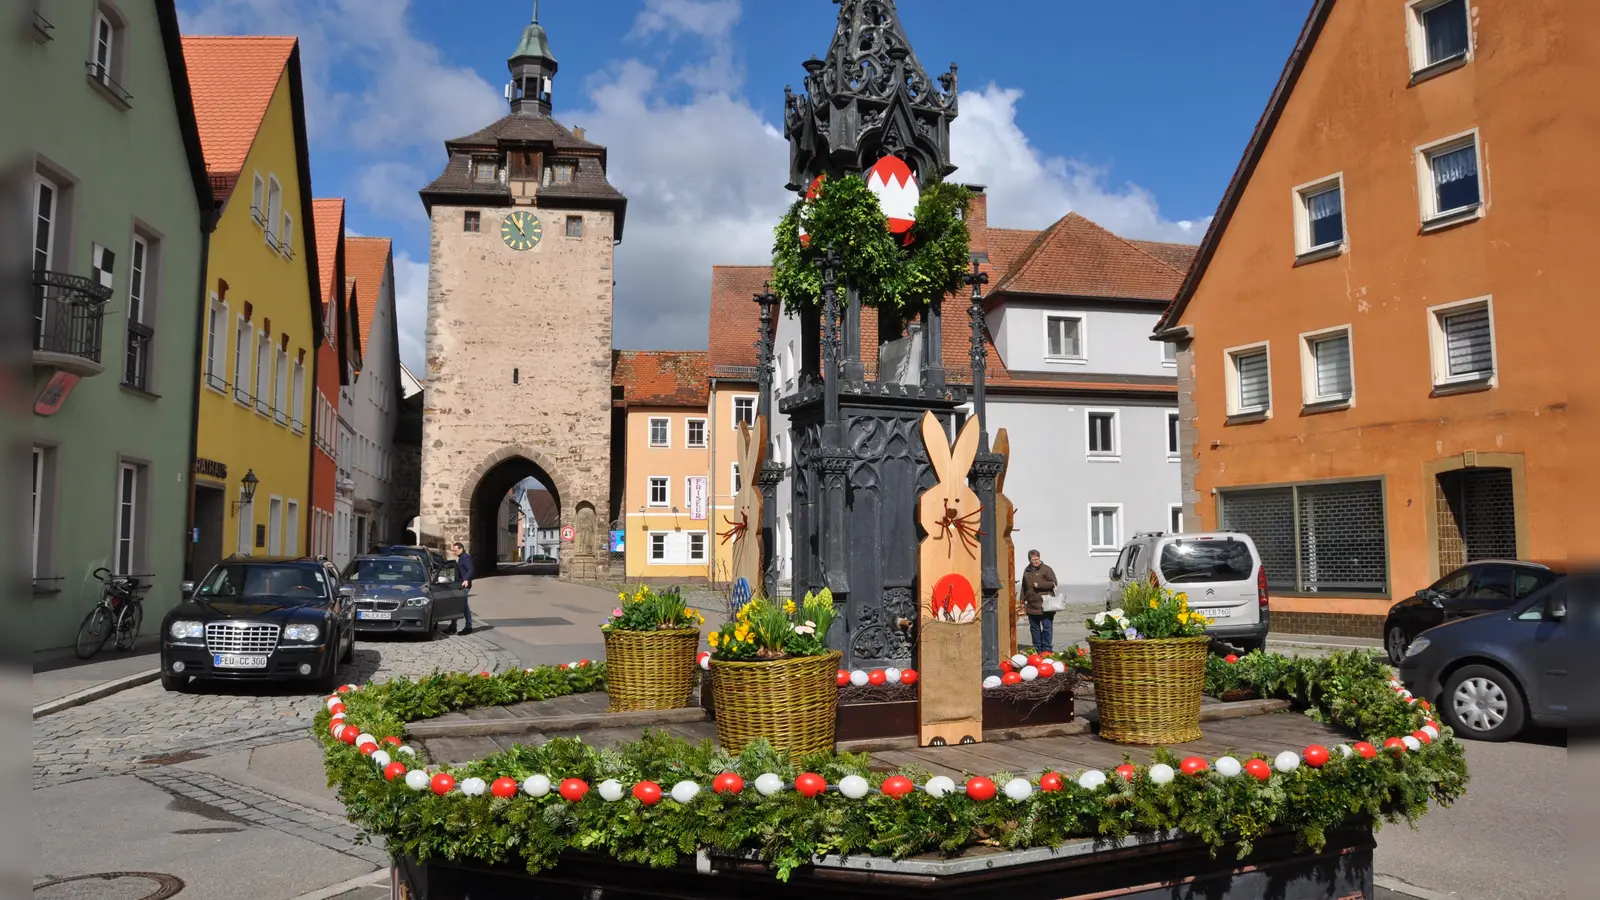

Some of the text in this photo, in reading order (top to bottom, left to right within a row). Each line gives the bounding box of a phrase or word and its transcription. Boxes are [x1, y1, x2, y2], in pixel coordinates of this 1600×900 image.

[196, 457, 227, 479] RATHAUS
[220, 656, 266, 666] FEU CC 300
